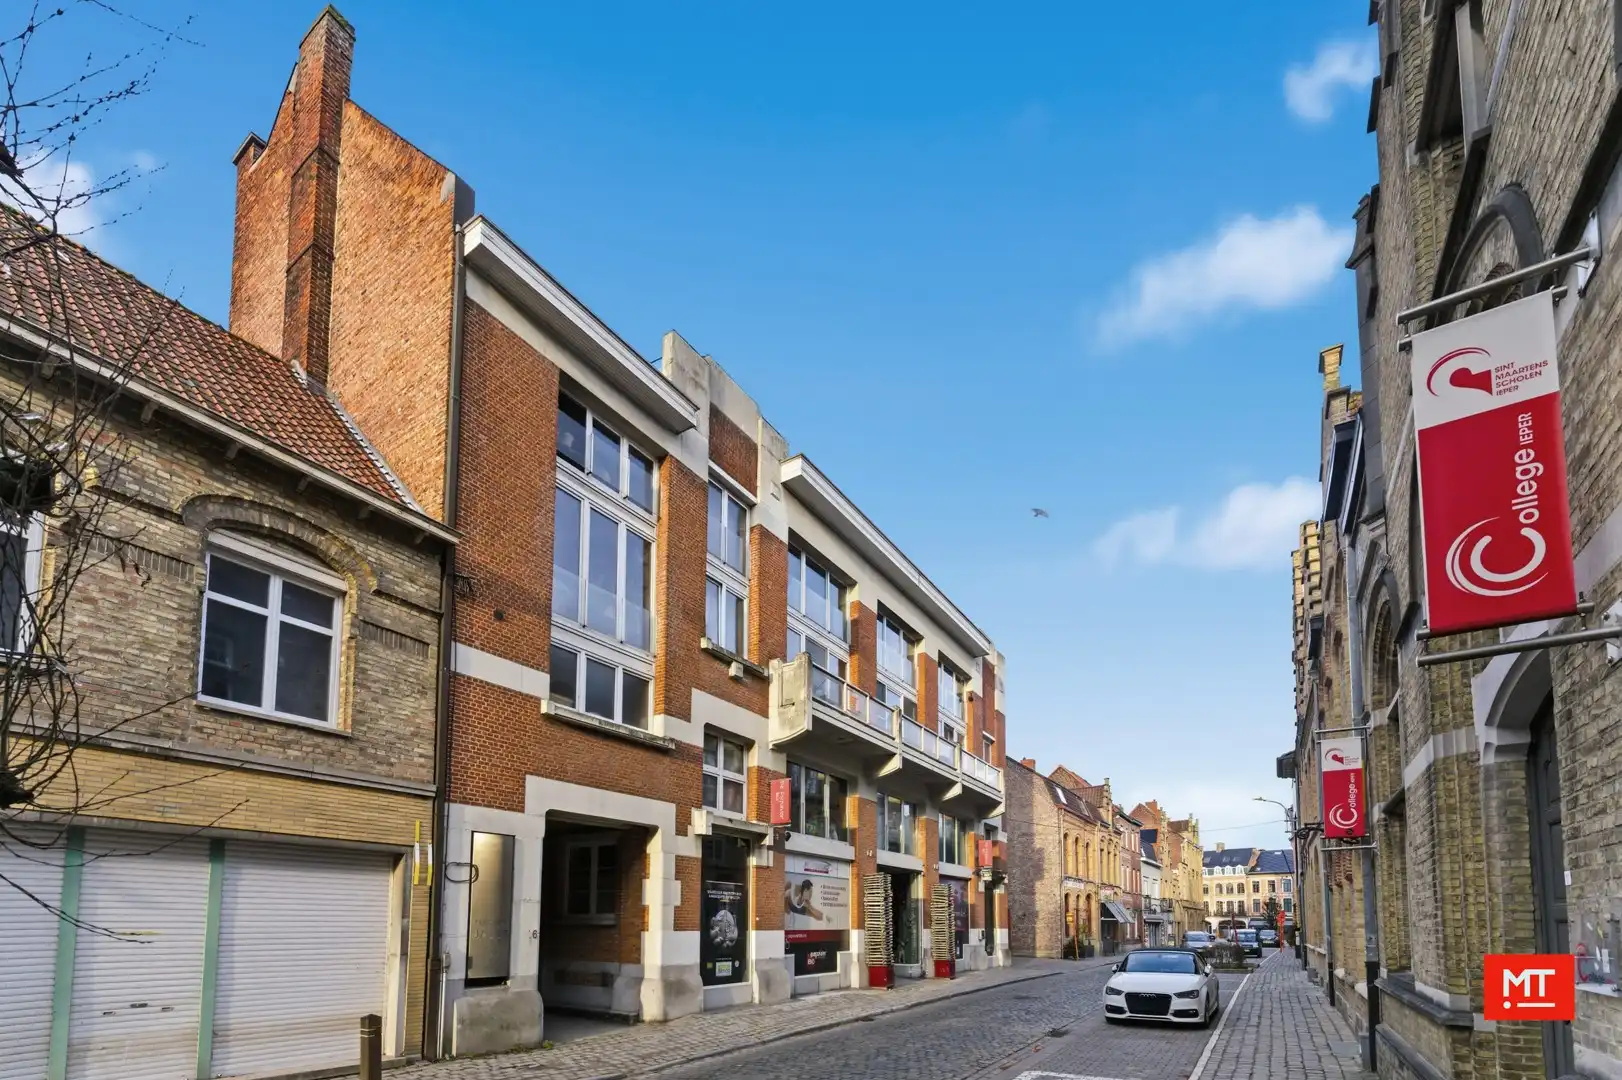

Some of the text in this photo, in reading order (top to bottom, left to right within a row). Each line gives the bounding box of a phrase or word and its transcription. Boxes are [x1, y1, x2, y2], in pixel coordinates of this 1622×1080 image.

[1494, 361, 1515, 373] SINT
[1495, 360, 1548, 380] MAARTENS
[1495, 370, 1542, 388] SCHOLEN
[1496, 385, 1519, 396] IEPER
[1468, 411, 1547, 583] College IEPER
